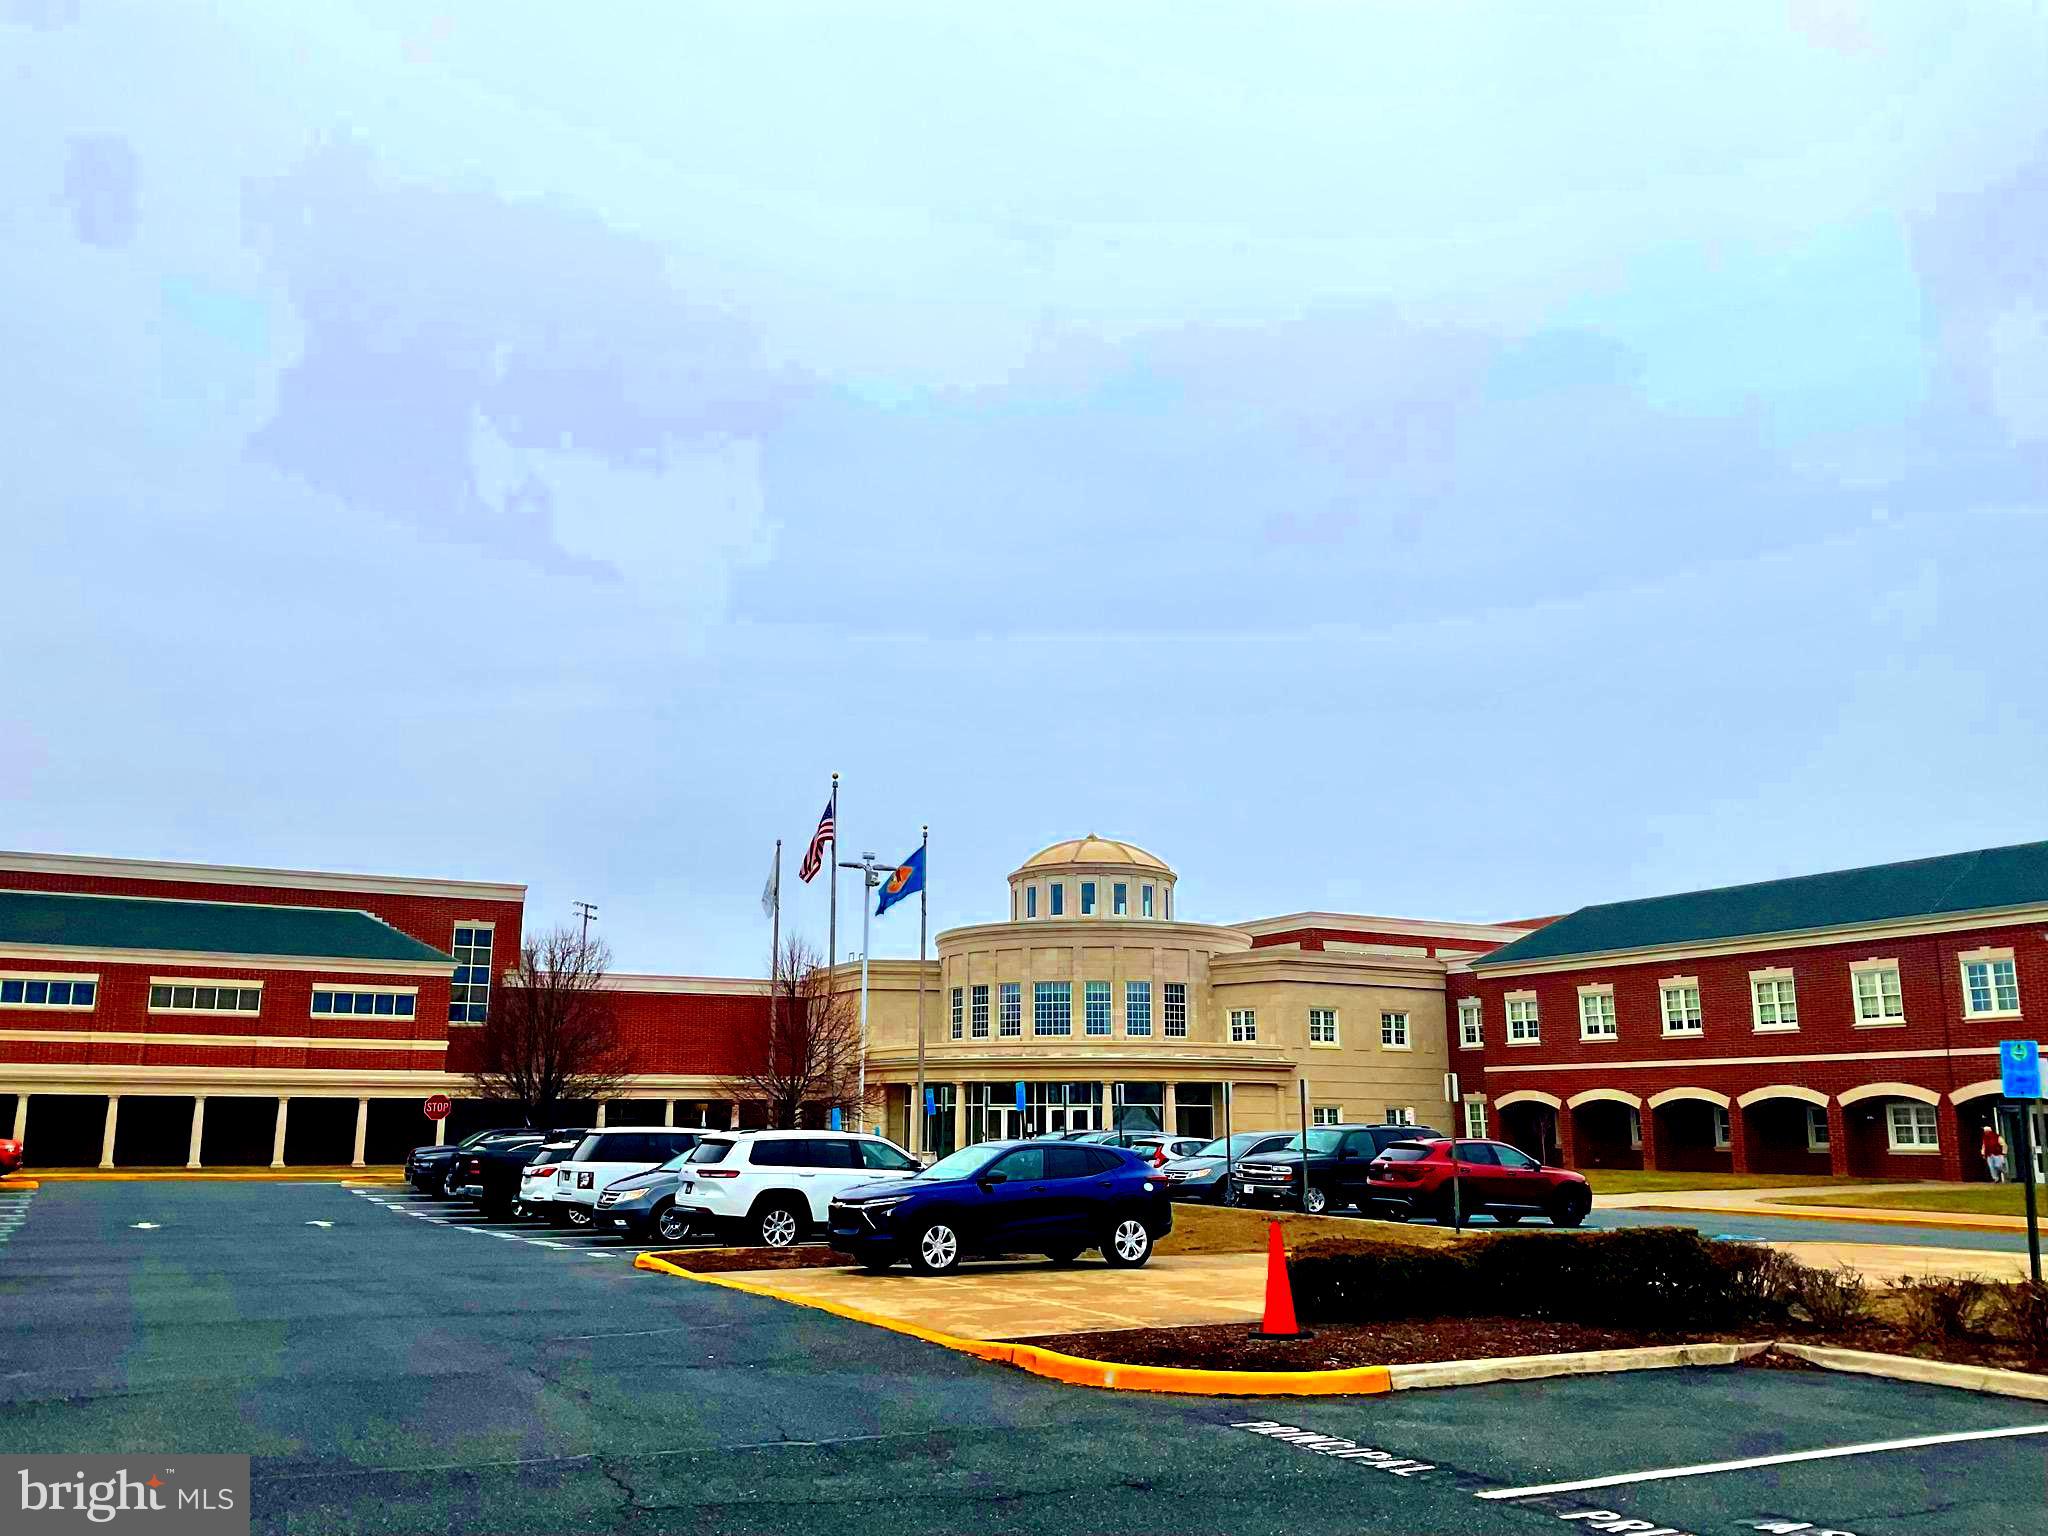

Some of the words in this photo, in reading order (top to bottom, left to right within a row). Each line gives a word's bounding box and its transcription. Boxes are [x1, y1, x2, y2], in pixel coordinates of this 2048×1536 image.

[426, 1102, 449, 1112] STOP
[1230, 1421, 1436, 1477] PRINCIPAL
[1557, 1509, 1694, 1536] PRI
